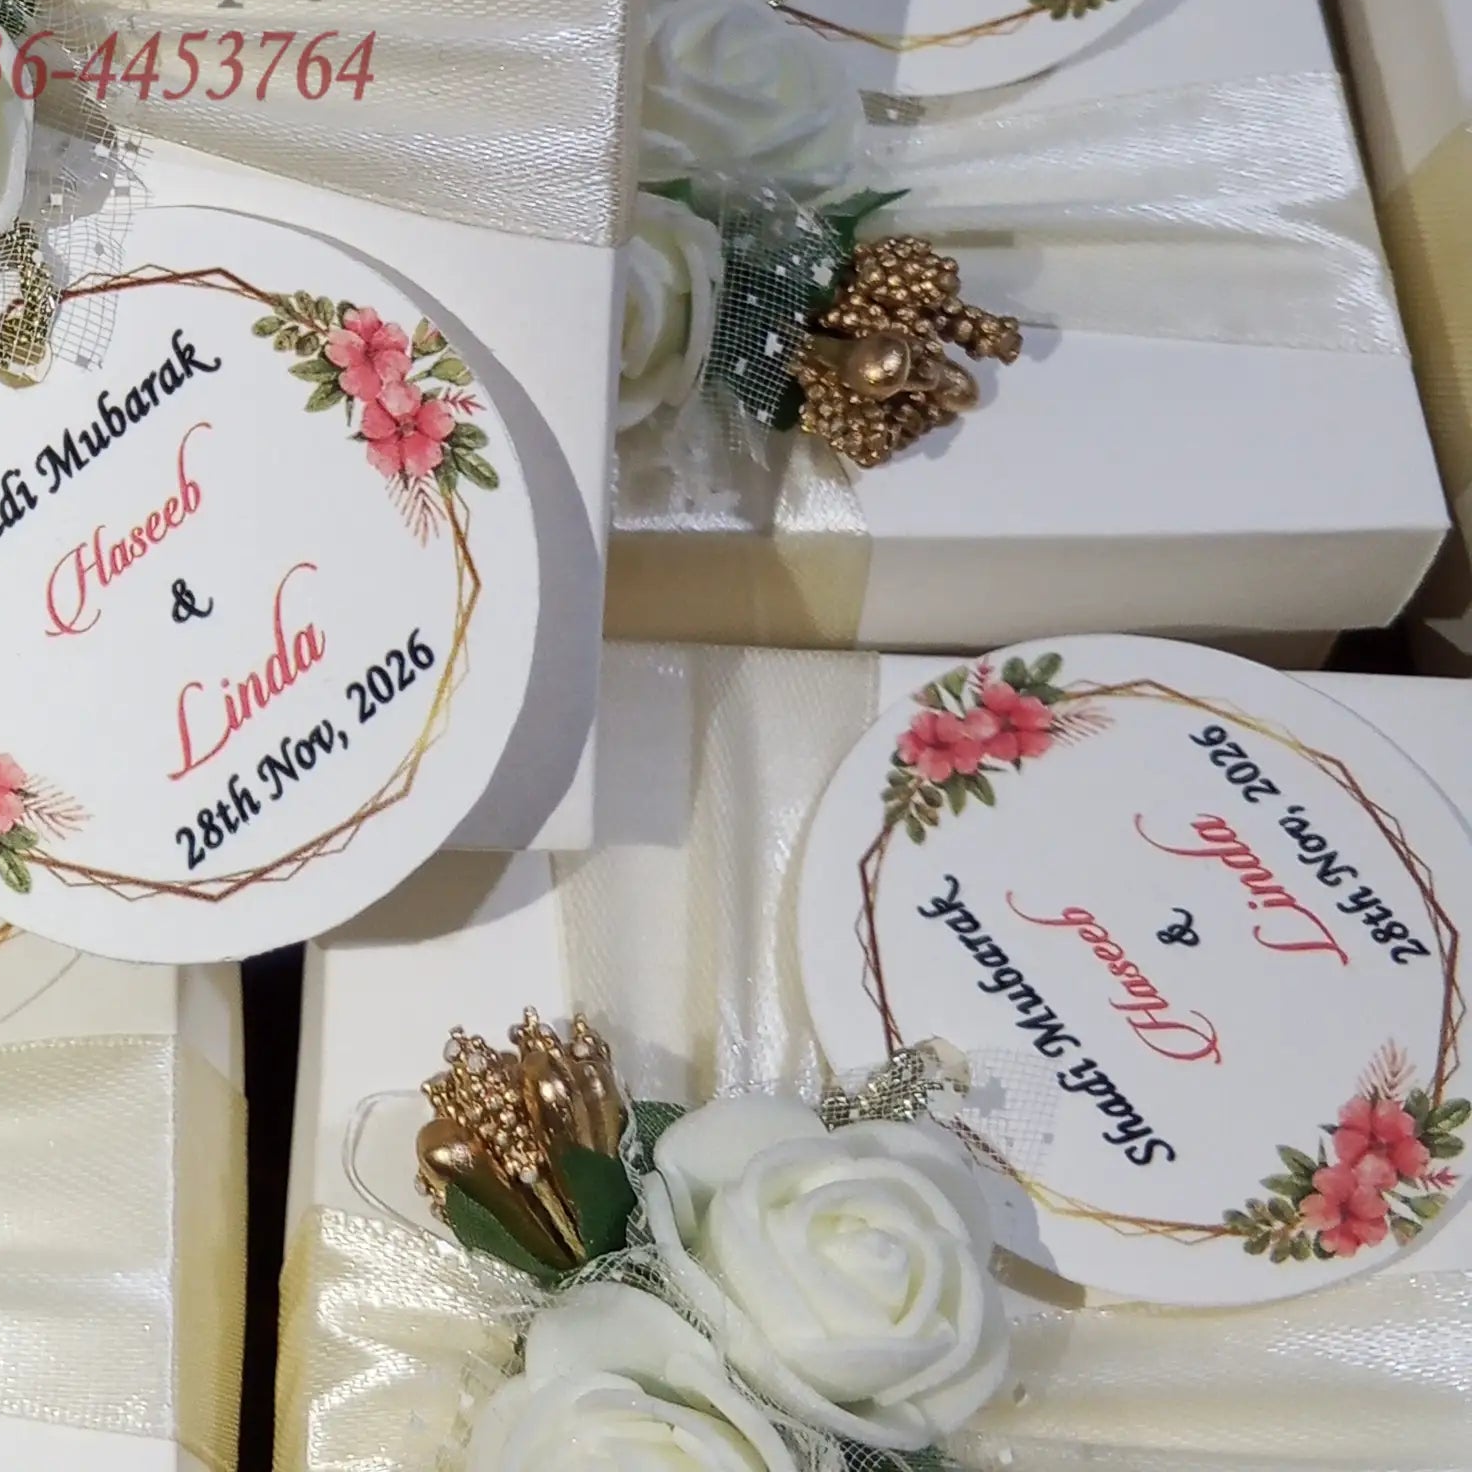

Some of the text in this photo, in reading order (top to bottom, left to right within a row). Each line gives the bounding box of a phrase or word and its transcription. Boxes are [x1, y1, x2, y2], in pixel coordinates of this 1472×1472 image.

[36, 329, 221, 493] Mubarak
[45, 421, 212, 638] Haseeb
[172, 579, 213, 623] &
[167, 563, 326, 782] Linda
[176, 629, 434, 870] 28th Nov, 2026
[1136, 815, 1350, 966] Linda
[1157, 908, 1200, 947] &
[1189, 726, 1430, 964] 28th Nov, 2026
[918, 875, 1176, 1165] Shadi Mubarak
[1006, 892, 1223, 1063] Haseeb
